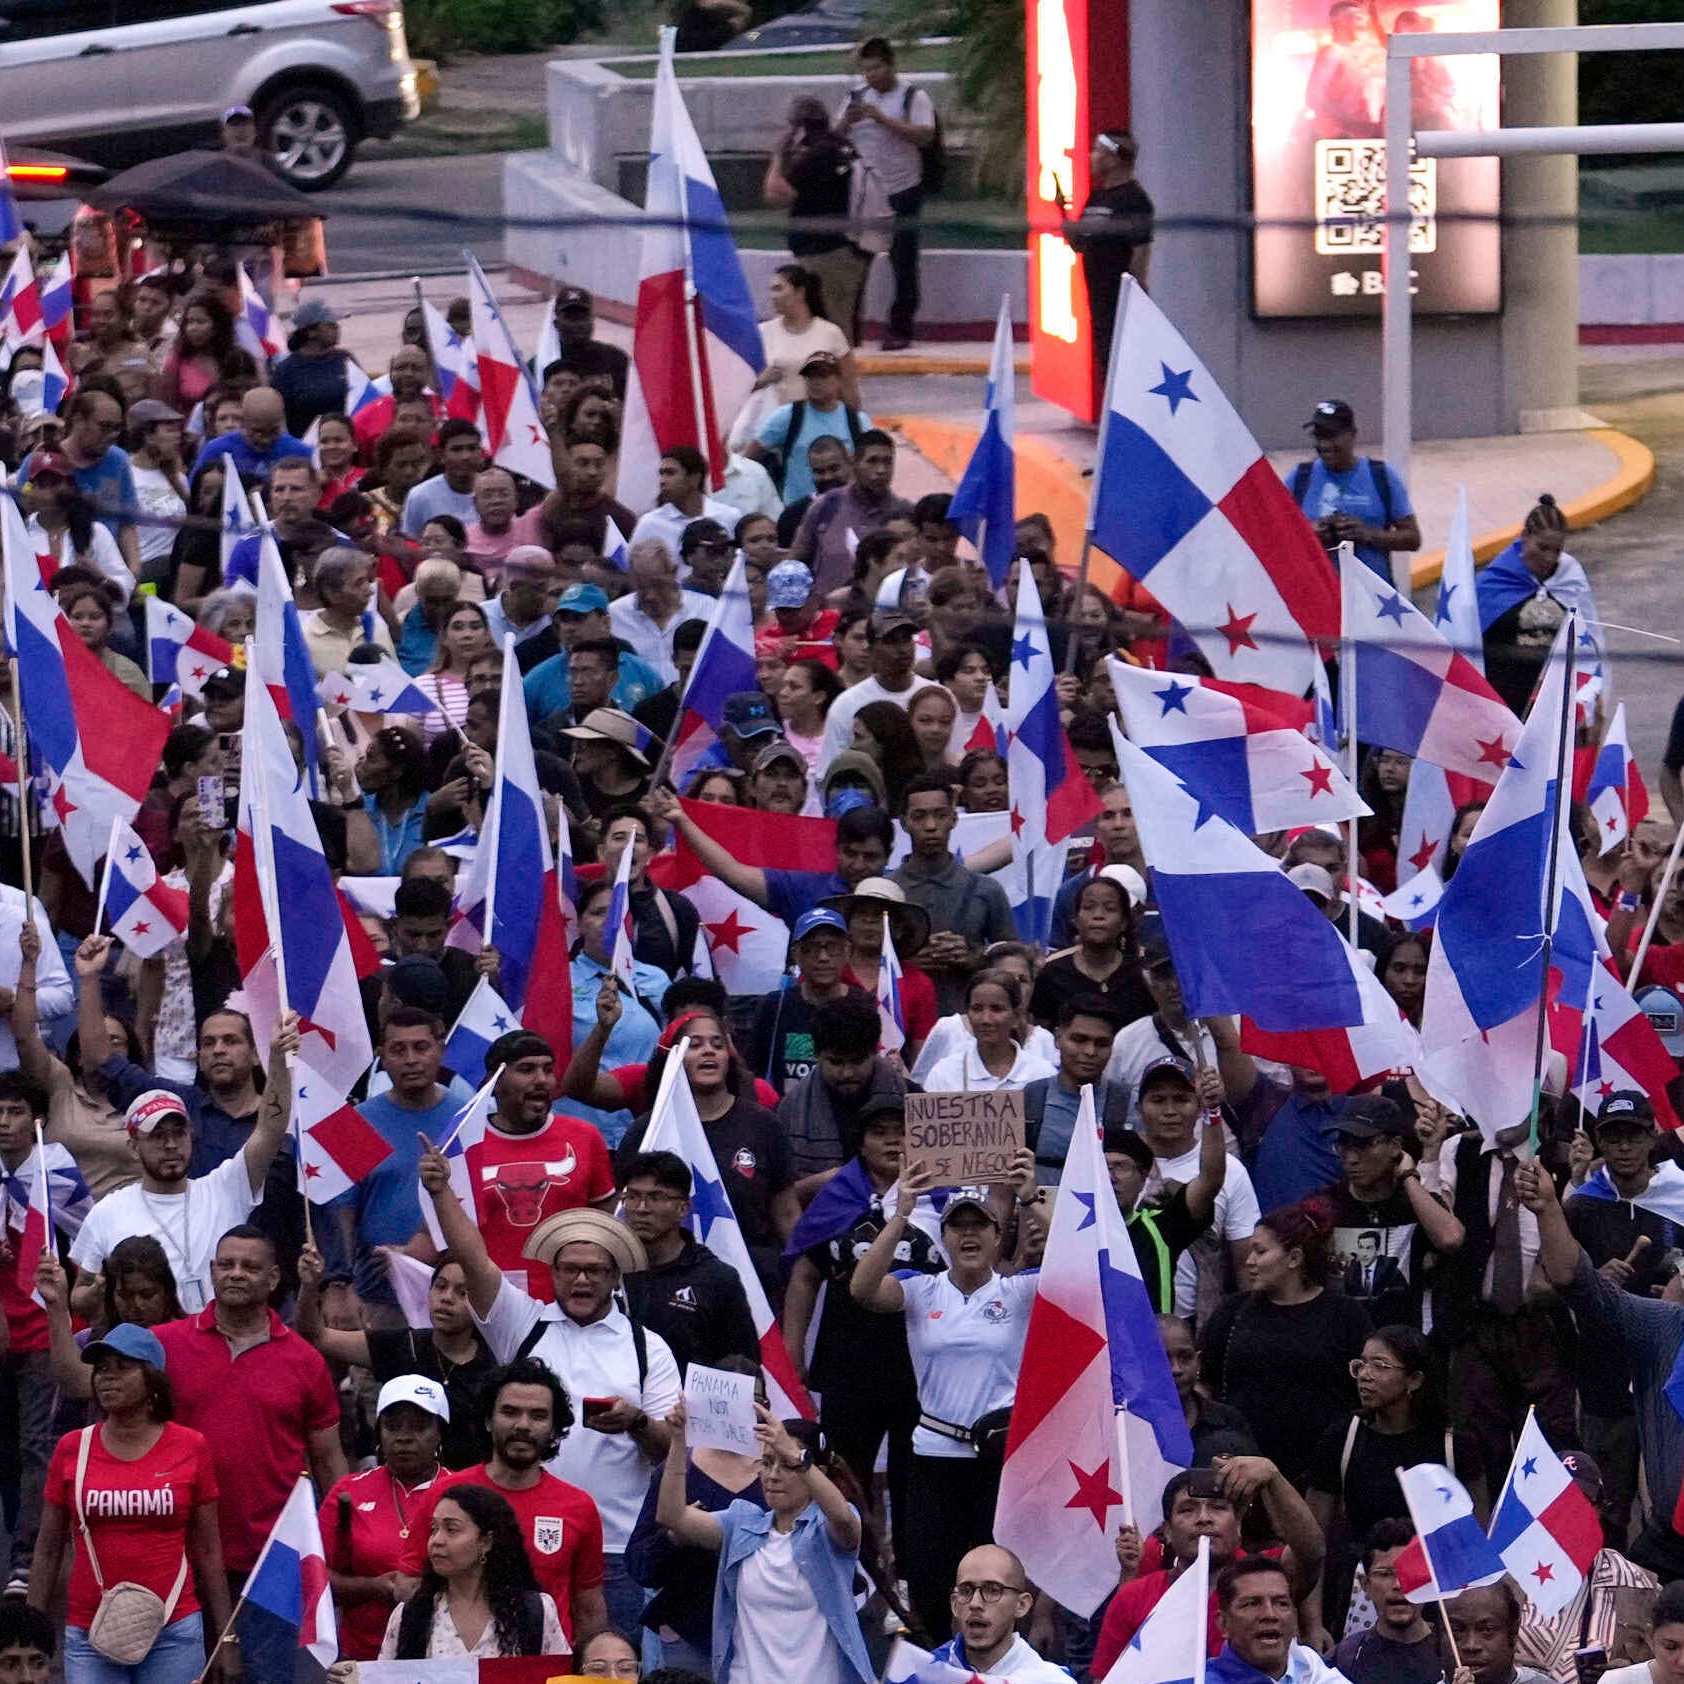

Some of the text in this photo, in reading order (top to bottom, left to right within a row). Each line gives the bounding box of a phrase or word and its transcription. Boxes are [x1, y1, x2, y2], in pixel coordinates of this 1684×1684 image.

[906, 1093, 1017, 1122] NUESTRA
[908, 1120, 1016, 1149] SOBERANÍA
[691, 1370, 740, 1398] PANAMA
[85, 1483, 174, 1516] PANAMÁ
